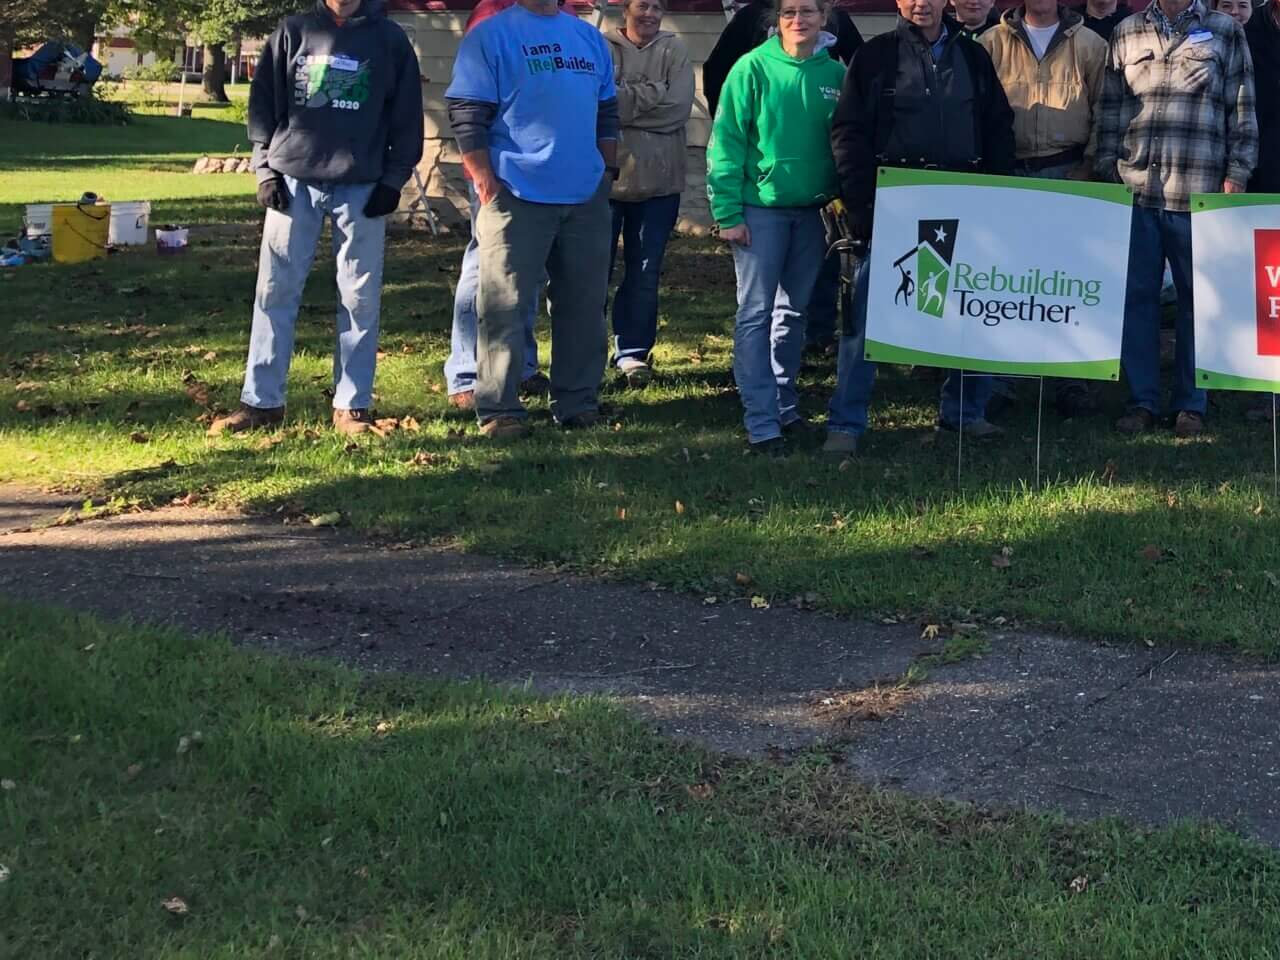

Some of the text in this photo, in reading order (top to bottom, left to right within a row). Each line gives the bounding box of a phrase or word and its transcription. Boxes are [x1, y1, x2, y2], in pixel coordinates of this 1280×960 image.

[522, 43, 562, 56] I am a
[332, 99, 360, 110] 2020
[953, 262, 1102, 307] Rebuilding
